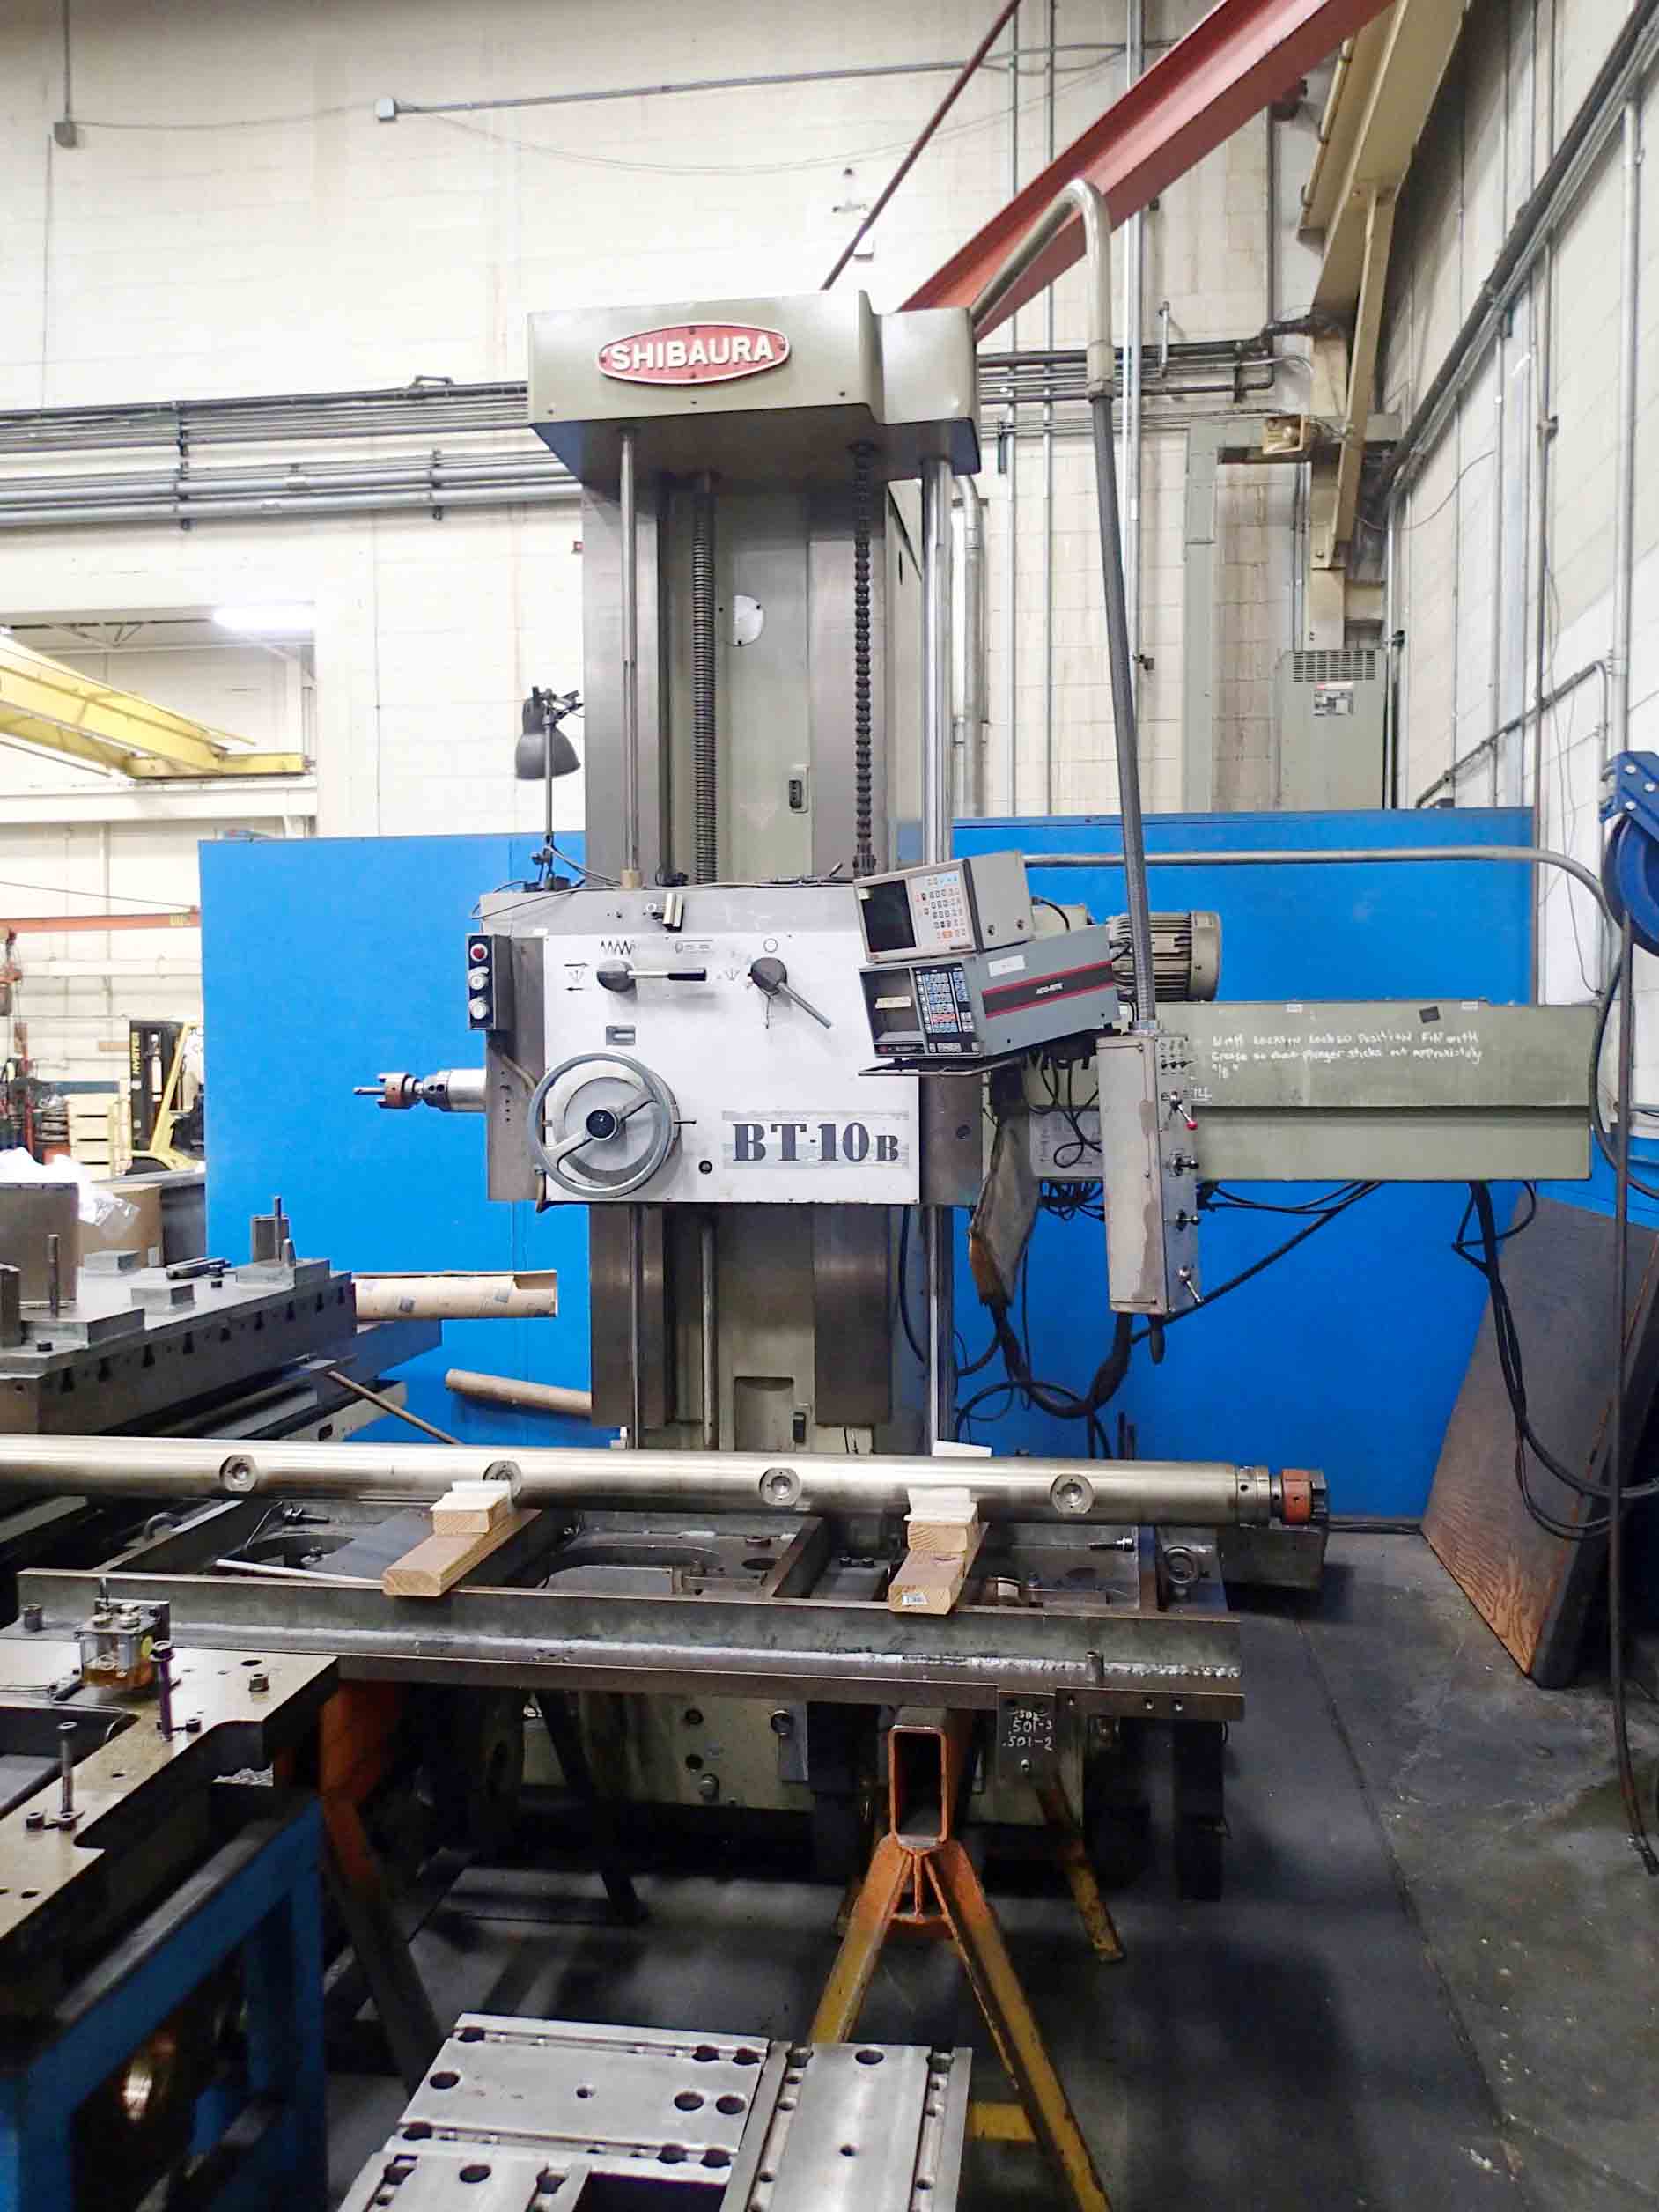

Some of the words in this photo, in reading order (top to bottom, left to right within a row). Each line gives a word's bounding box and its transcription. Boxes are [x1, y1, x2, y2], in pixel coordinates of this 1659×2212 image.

[611, 336, 775, 371] SHIBAURA
[733, 1122, 899, 1162] BT-10B
[1002, 1735, 1053, 1751] .501-2
